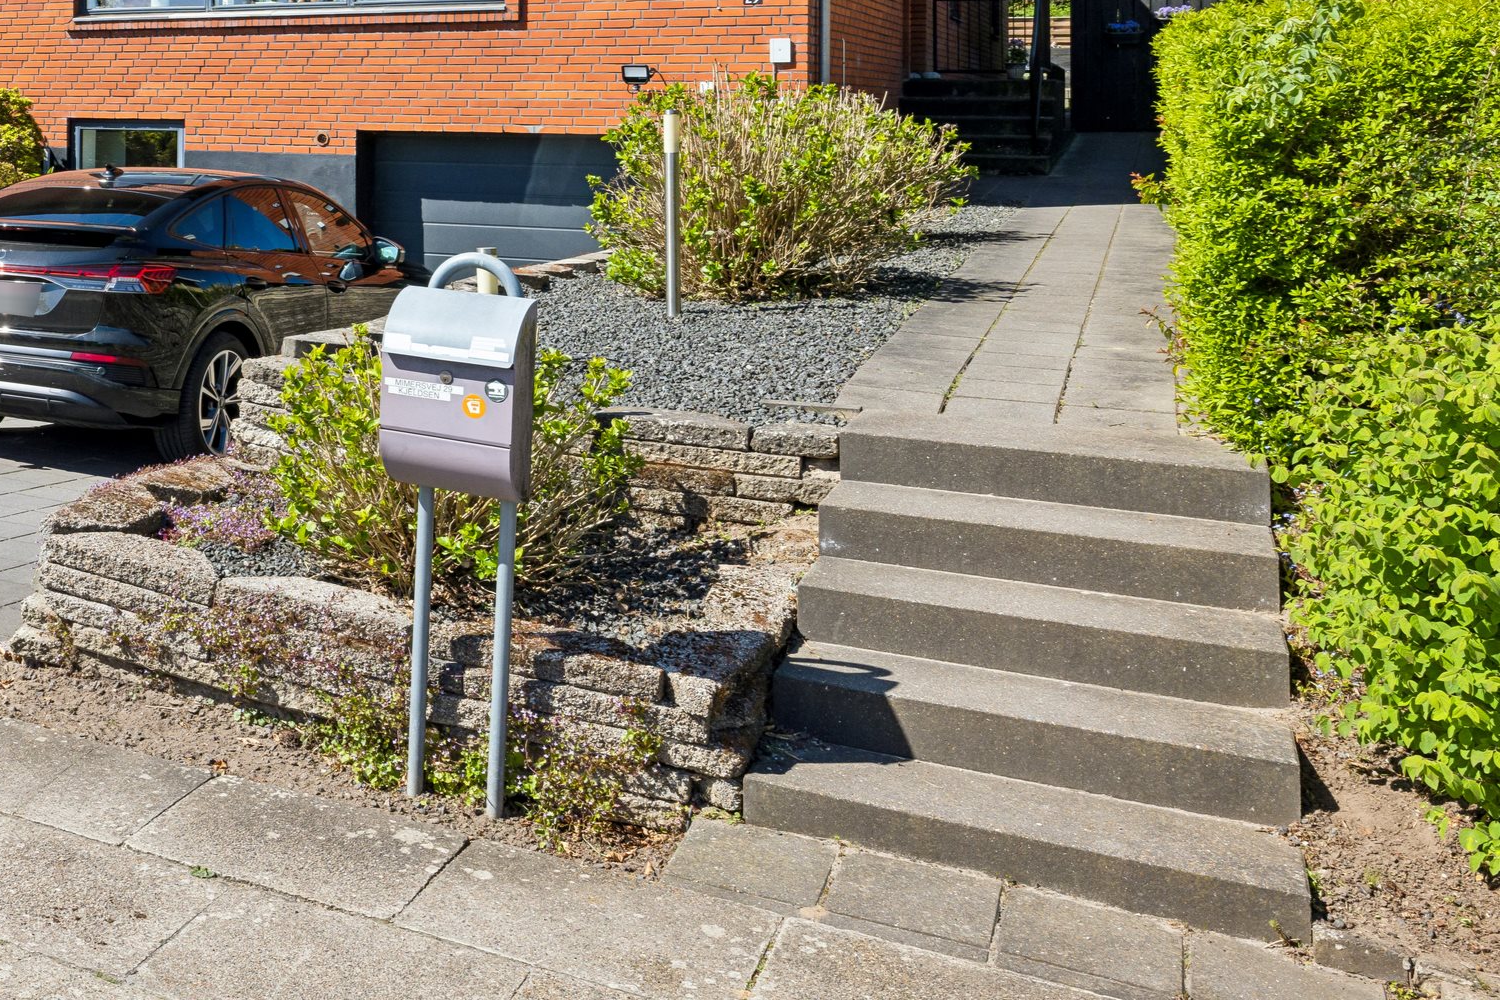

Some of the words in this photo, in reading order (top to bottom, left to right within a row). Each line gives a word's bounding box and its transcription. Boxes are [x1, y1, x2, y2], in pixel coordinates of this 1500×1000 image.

[395, 378, 442, 391] MIMERSVEJ
[443, 385, 453, 393] 29
[398, 387, 441, 399] KJELDSEN
